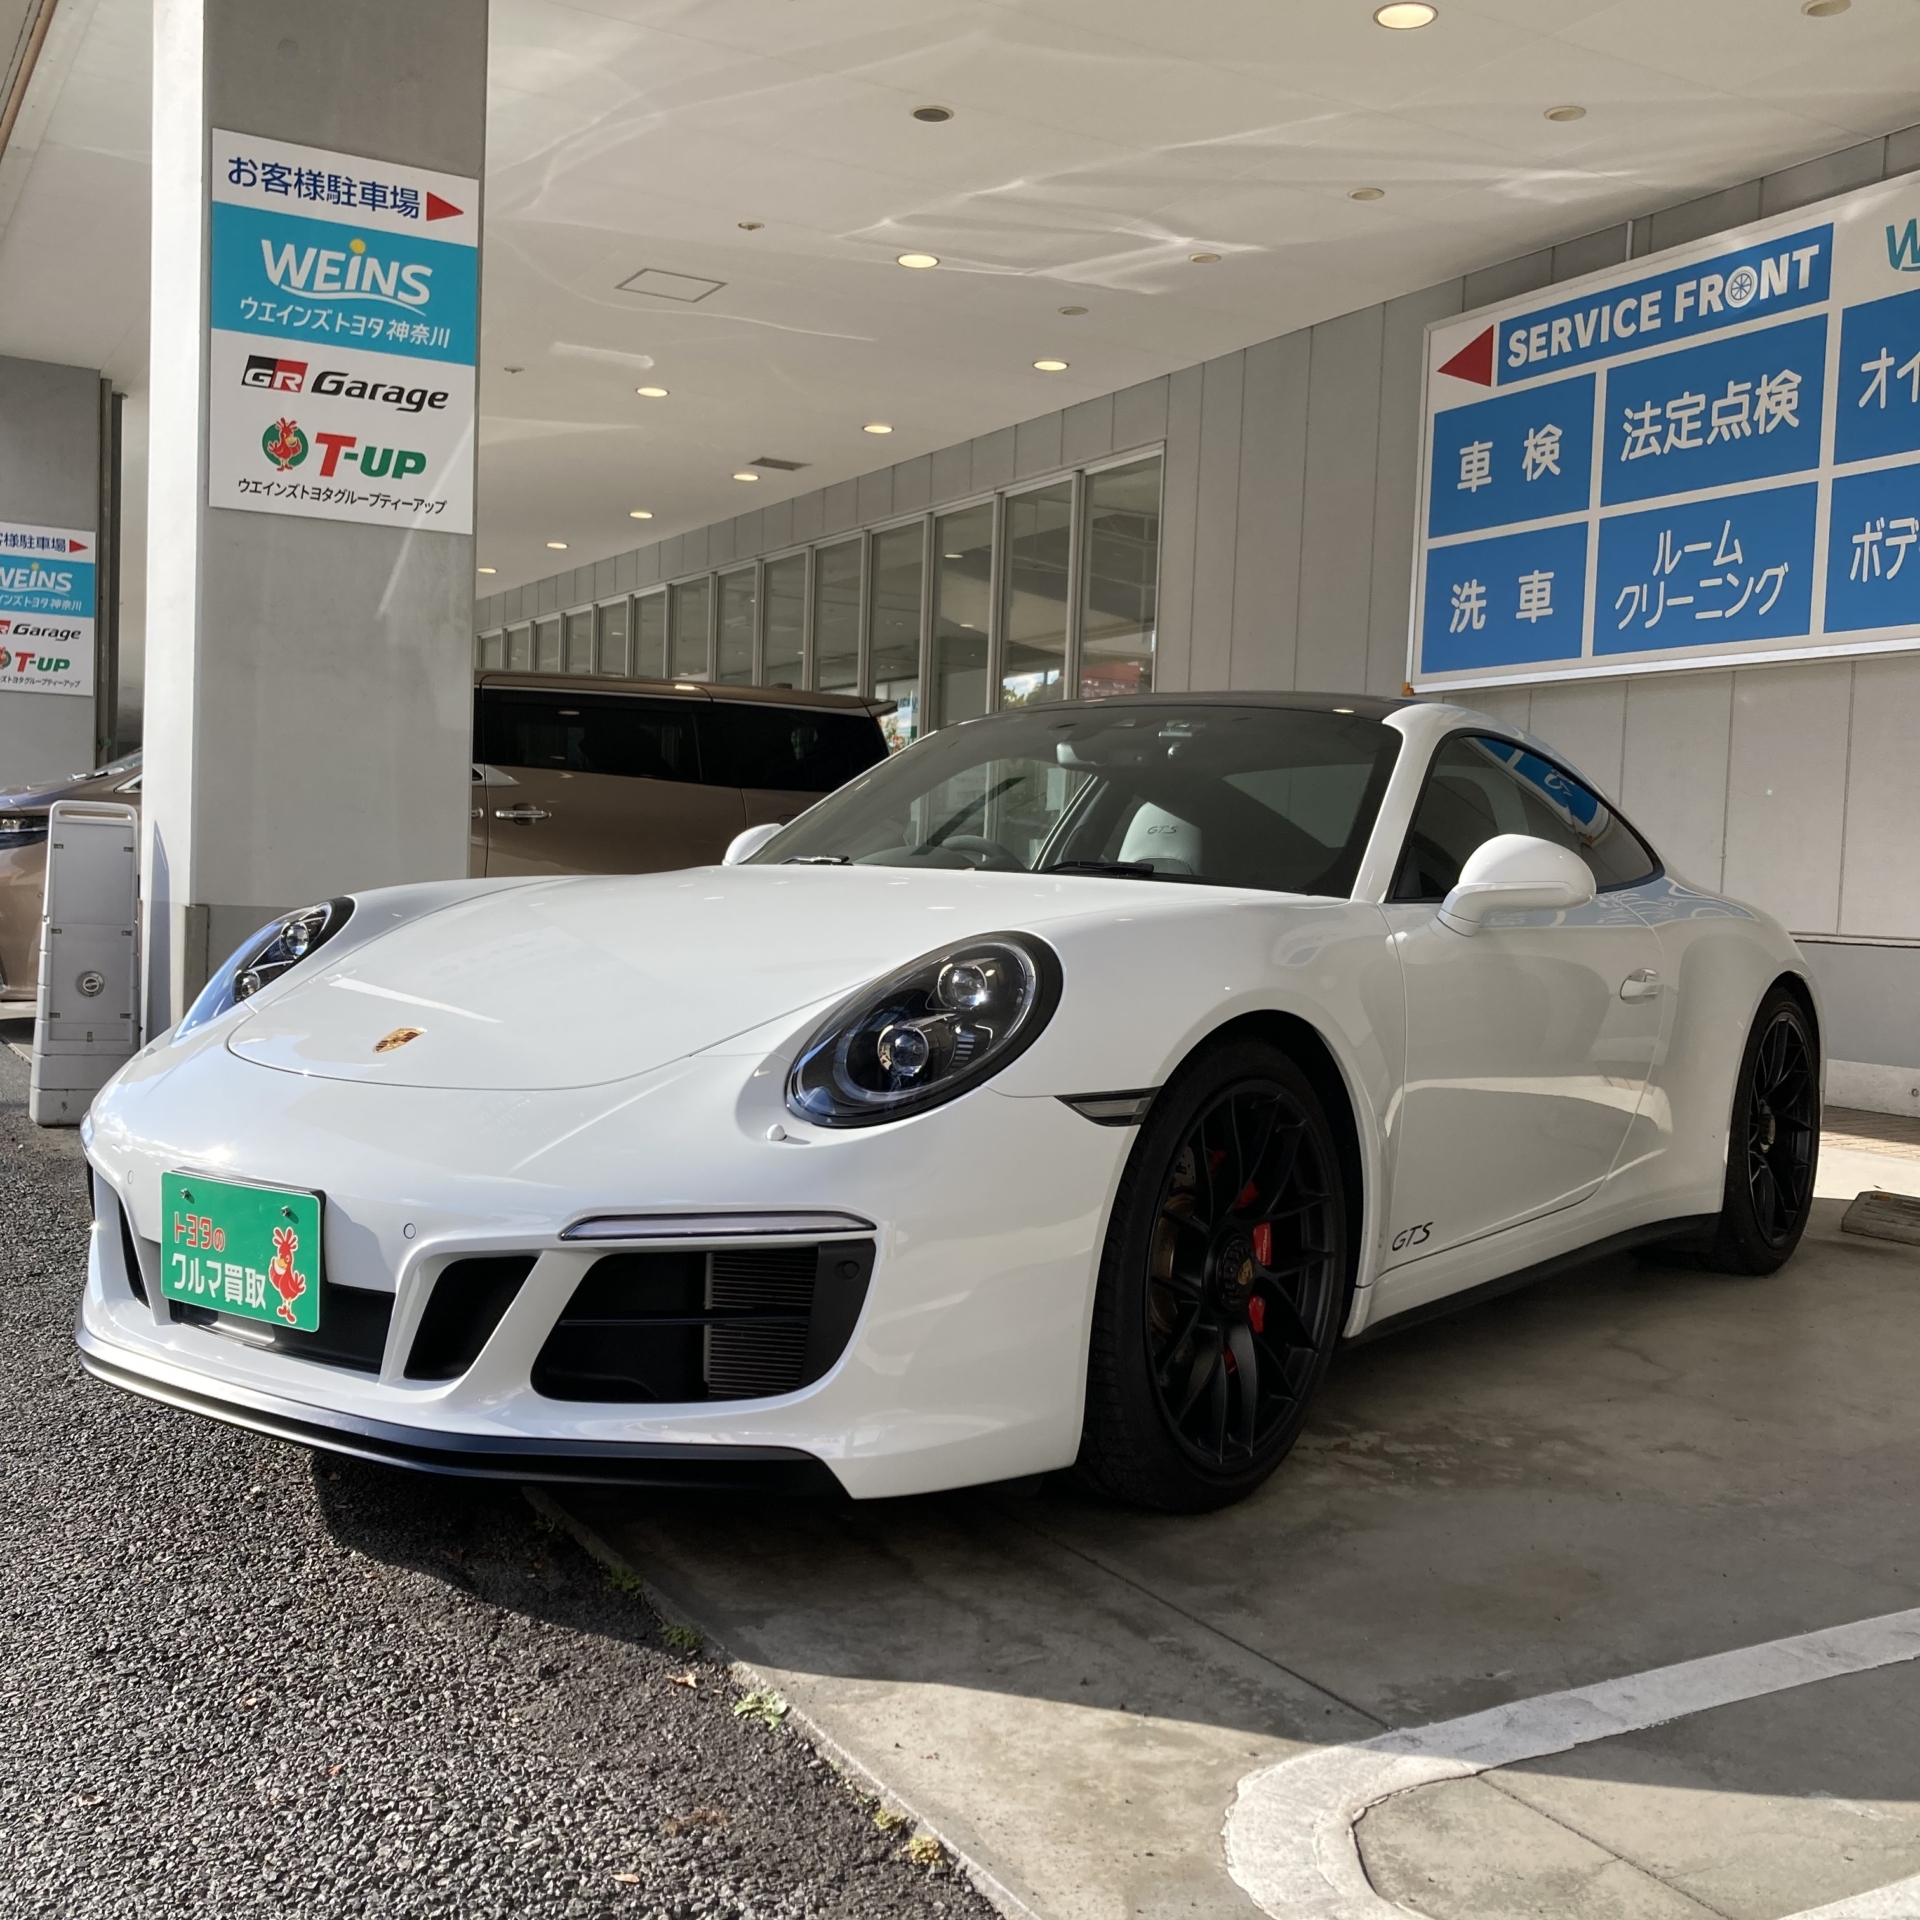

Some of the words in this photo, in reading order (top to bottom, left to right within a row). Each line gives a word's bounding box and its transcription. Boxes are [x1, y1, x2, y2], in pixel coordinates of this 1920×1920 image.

[227, 156, 421, 220] お客様駐車場
[1507, 290, 1662, 368] SERVICE
[1674, 244, 1820, 323] FRONT
[243, 366, 304, 392] GR
[310, 370, 449, 413] Garage
[1620, 368, 1802, 462] 法定点検
[314, 432, 427, 480] T-UP
[238, 477, 448, 515] ウエインズトヨタグループティーアップ
[0, 532, 66, 553] 様駐車場
[1652, 519, 1744, 576] ルーム
[1614, 562, 1789, 630] クリーニング
[13, 623, 81, 641] Garage
[15, 651, 70, 672] T-UP
[1147, 825, 1178, 834] GTS
[1392, 1221, 1434, 1252] GTS
[171, 1252, 267, 1311] クルマ買取
